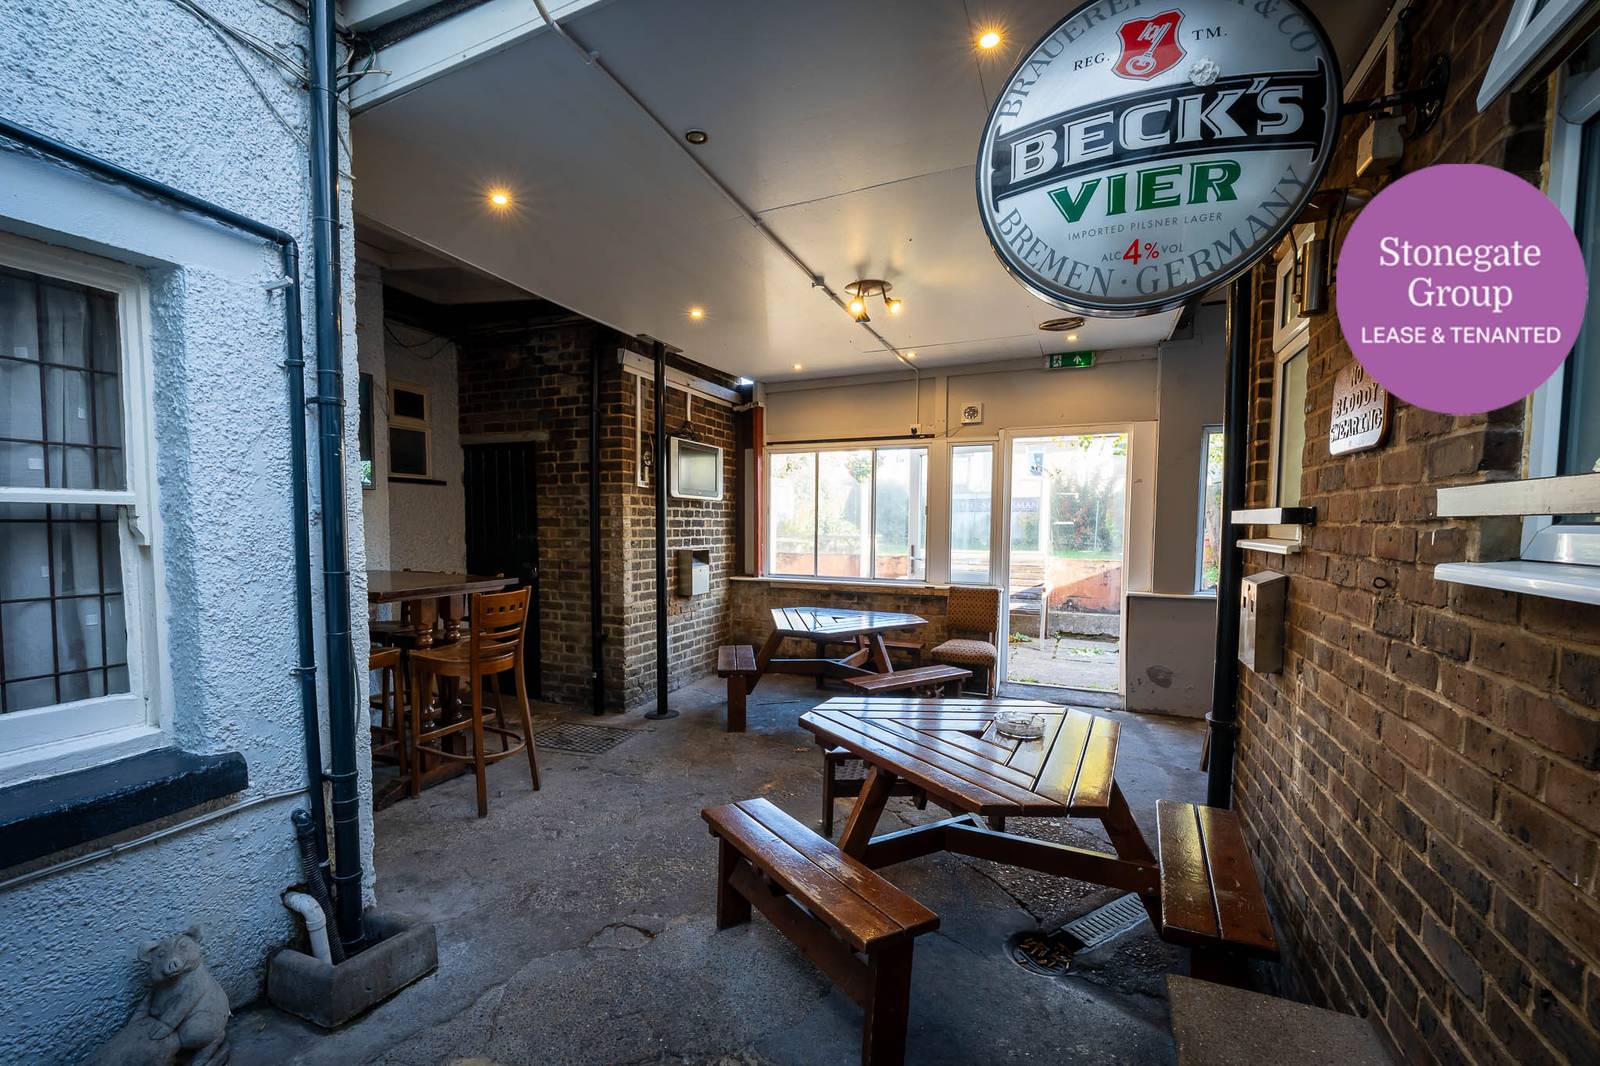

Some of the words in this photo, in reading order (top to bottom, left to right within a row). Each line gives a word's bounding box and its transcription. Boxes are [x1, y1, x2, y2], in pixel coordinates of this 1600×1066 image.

[1000, 0, 1141, 118] BRAUERE
[1278, 13, 1319, 52] CO
[1073, 52, 1110, 71] REG.
[1192, 27, 1227, 41] TM.
[1009, 77, 1304, 184] BECK'S
[1047, 159, 1241, 224] VIER
[998, 208, 1114, 296] BREMEN
[1136, 164, 1304, 295] GERMANY
[1068, 224, 1124, 240] IMPORTED
[1130, 217, 1178, 230] PILSNER
[1184, 213, 1222, 224] LAGER
[1335, 382, 1379, 418] BLOODY
